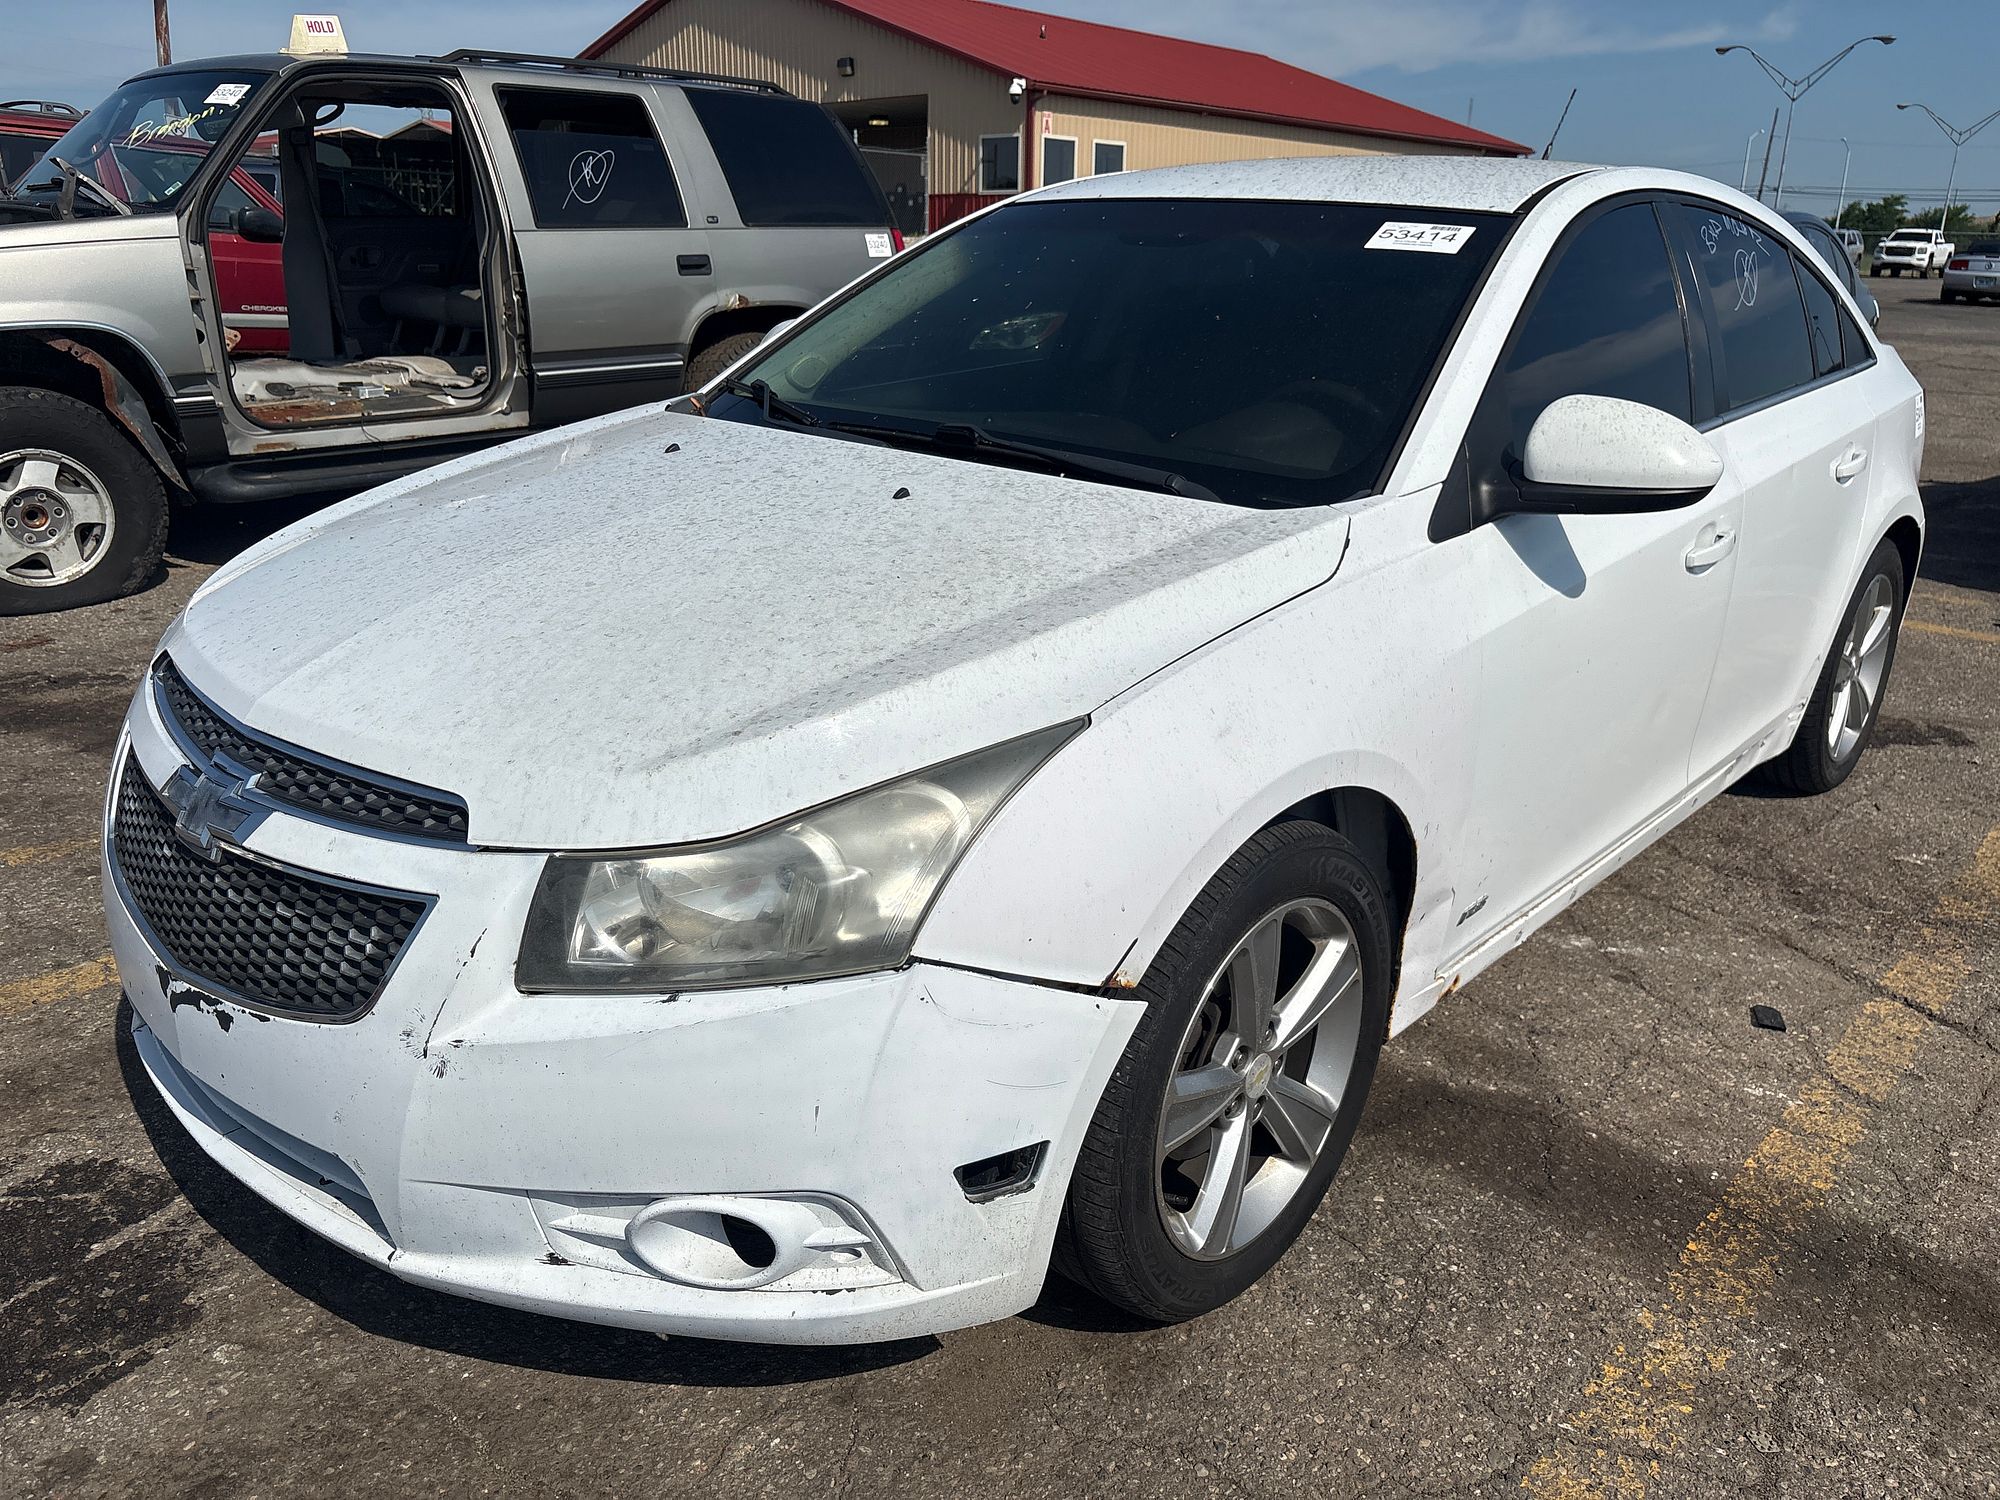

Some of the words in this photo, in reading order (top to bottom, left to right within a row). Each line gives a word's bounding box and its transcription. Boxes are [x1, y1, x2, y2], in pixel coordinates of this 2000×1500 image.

[306, 20, 335, 33] HOLD
[212, 89, 242, 97] 53240
[1044, 119, 1051, 134] A
[1378, 228, 1458, 243] 53414
[1700, 219, 1723, 255] BAD
[868, 240, 888, 249] 53240
